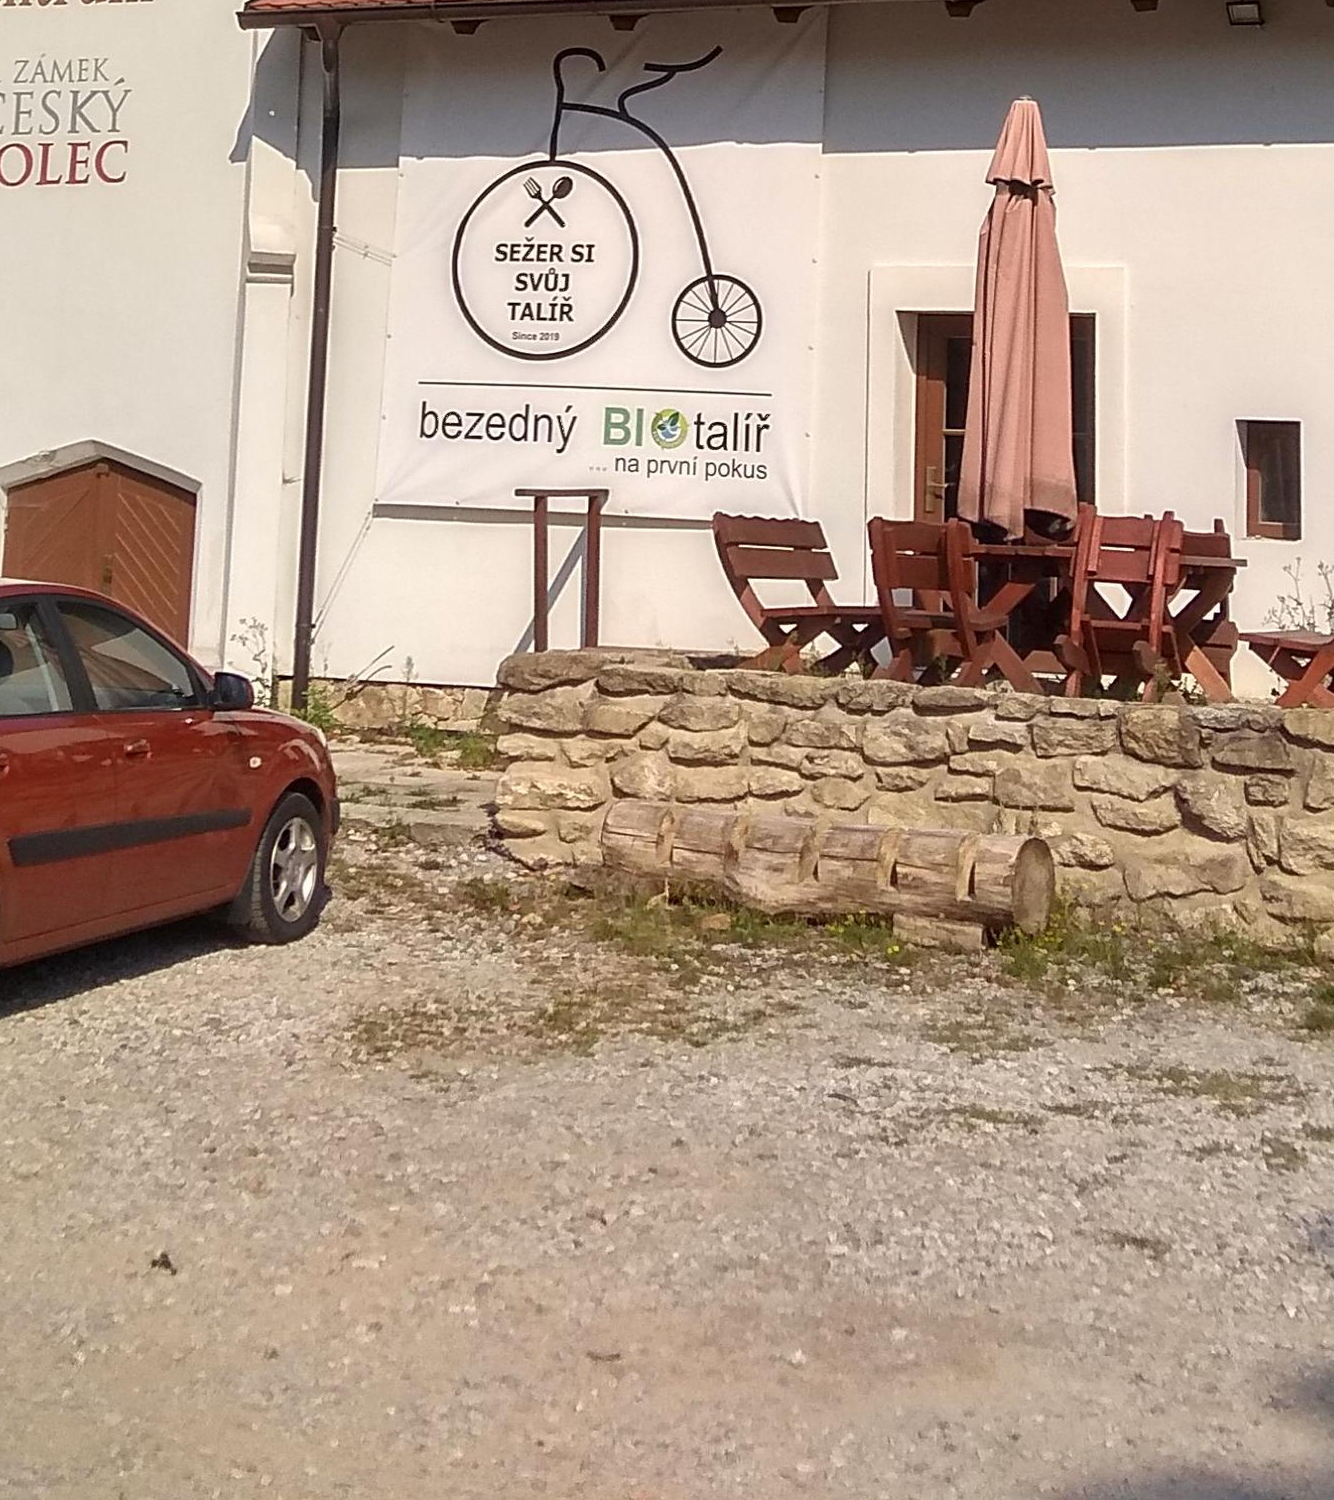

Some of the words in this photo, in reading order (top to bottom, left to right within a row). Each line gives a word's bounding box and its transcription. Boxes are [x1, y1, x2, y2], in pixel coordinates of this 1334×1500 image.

[13, 54, 109, 84] ZÁMEK
[495, 236, 564, 263] SEŽER
[570, 243, 596, 263] SI
[514, 267, 570, 292] SVŮJ
[507, 296, 574, 321] TALÍŘ
[512, 331, 537, 341] Since
[539, 332, 560, 341] 2019
[419, 400, 578, 454] bezedný
[614, 457, 640, 473] na
[647, 456, 698, 479] první
[704, 458, 768, 481] pokus
